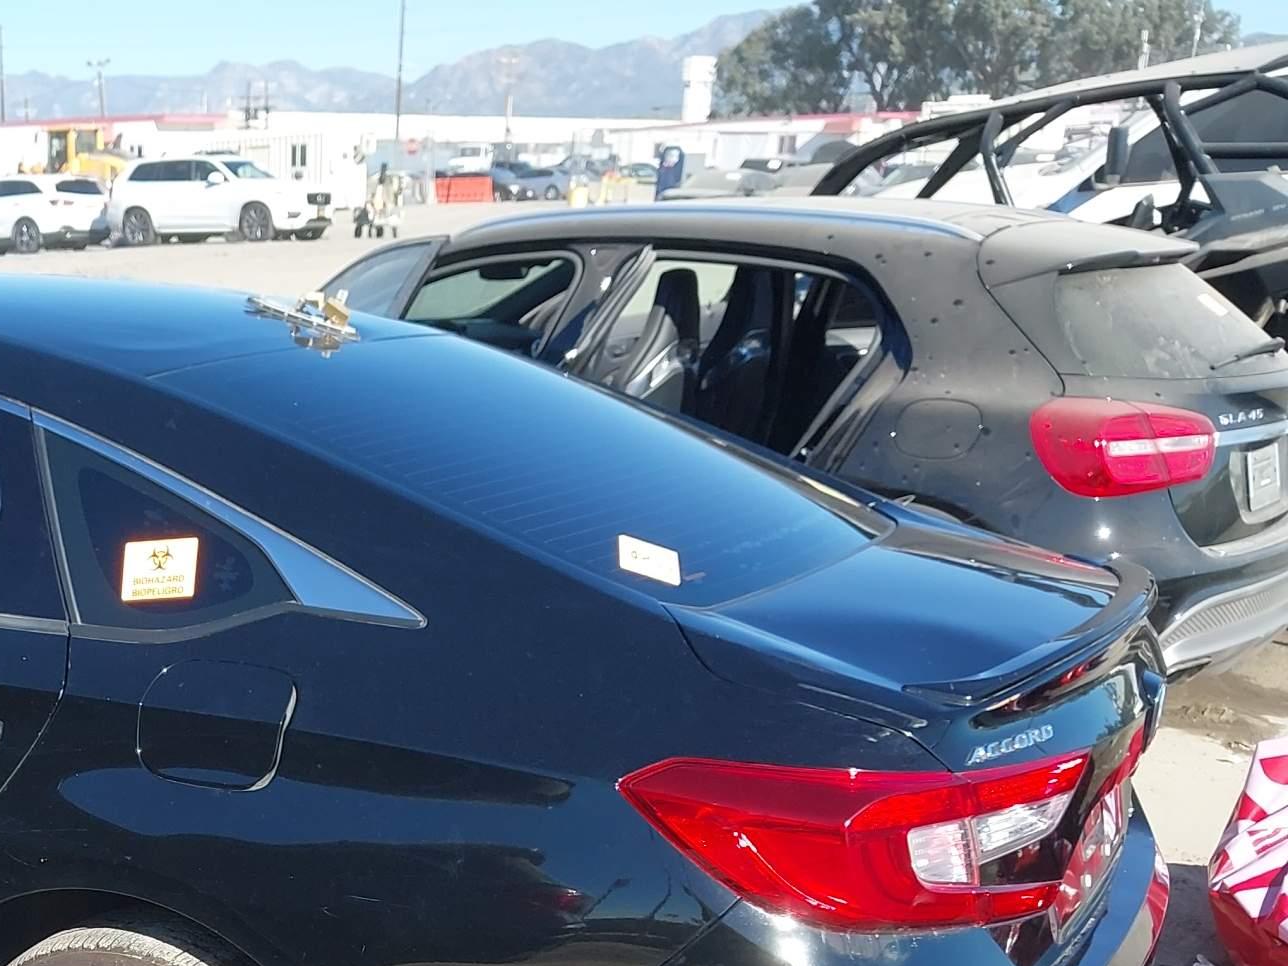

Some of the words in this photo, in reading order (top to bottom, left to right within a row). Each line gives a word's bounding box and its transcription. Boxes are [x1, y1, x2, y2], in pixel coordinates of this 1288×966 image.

[1248, 408, 1264, 421] 45
[132, 574, 185, 586] BIOHAZARD
[131, 586, 184, 597] BIOPELIGRO
[966, 724, 1054, 766] ACCORD
